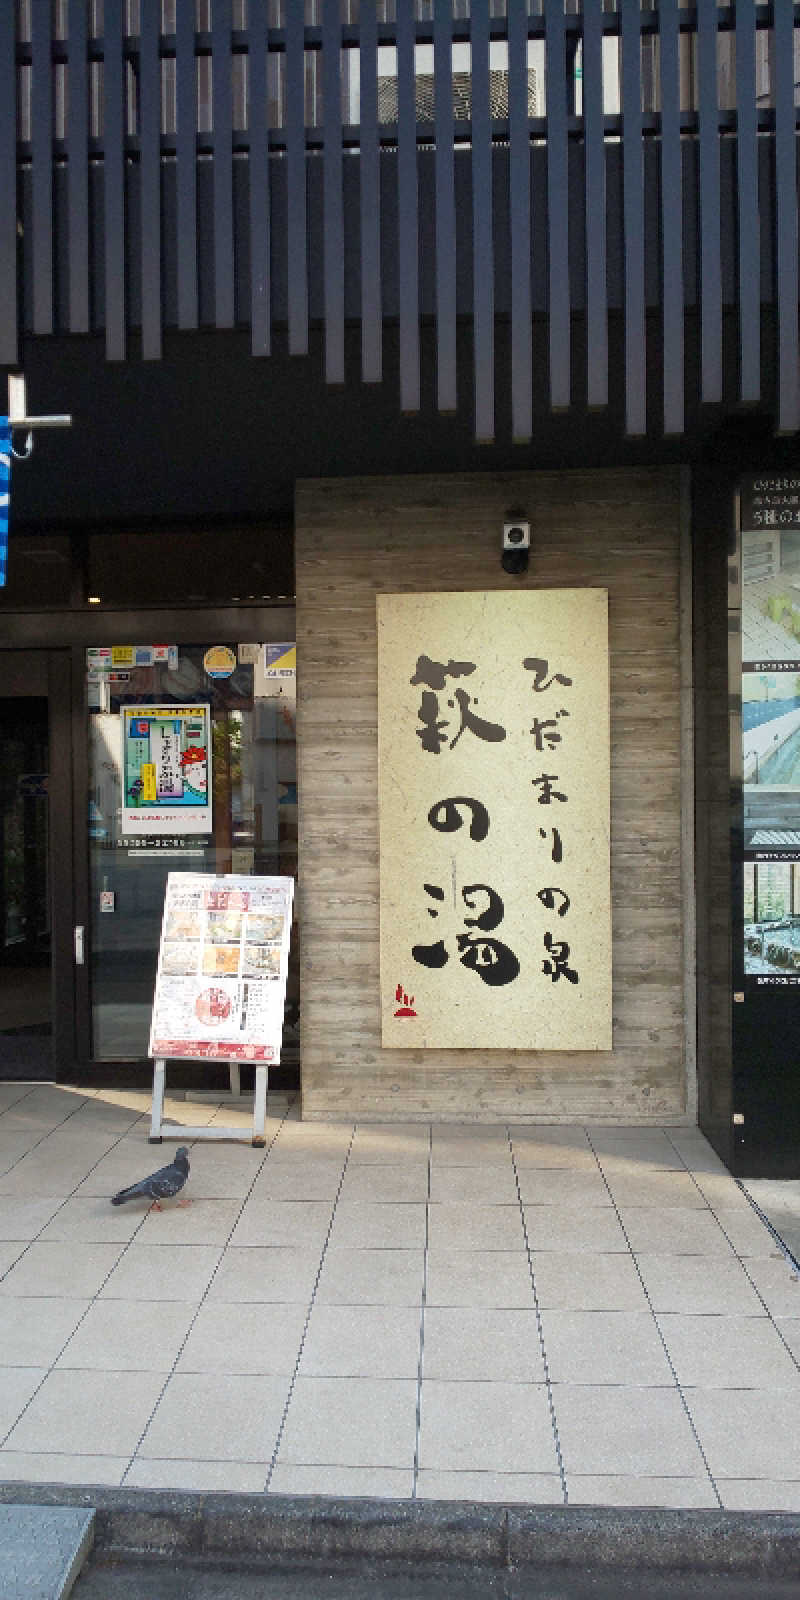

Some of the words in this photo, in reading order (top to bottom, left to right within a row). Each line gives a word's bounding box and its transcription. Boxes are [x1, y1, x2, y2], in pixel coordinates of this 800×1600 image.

[410, 655, 520, 986] 萩の湯
[523, 657, 579, 984] ひだまりの泉
